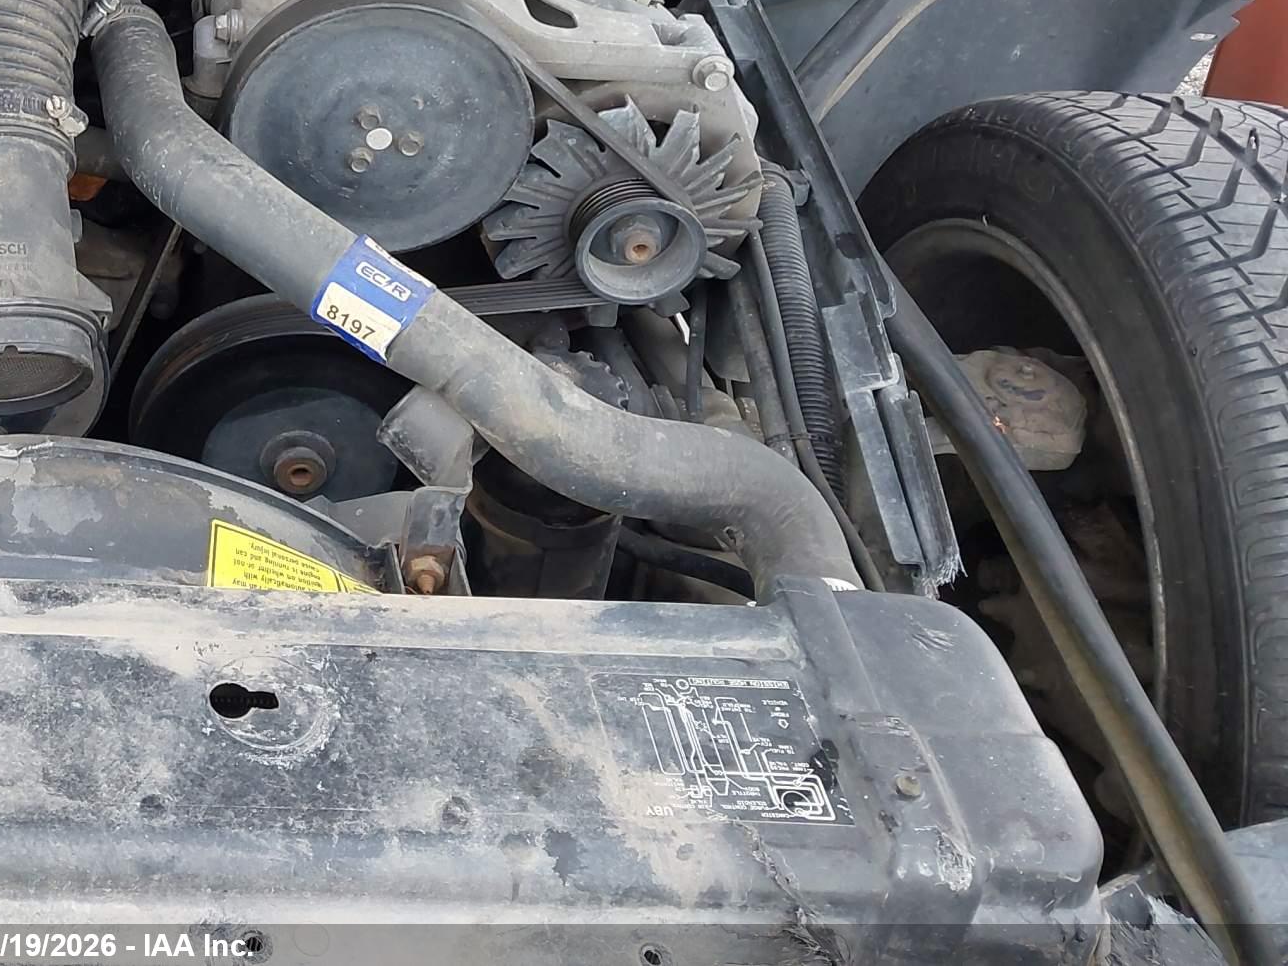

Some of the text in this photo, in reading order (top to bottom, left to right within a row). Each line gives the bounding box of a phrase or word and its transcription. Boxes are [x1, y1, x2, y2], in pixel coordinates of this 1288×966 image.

[326, 304, 377, 341] 8197
[235, 548, 248, 557] can
[233, 558, 245, 568] not
[249, 554, 262, 563] and
[264, 557, 290, 571] running
[271, 551, 299, 566] personal
[257, 565, 285, 578] whether
[301, 562, 320, 573] cause
[243, 570, 258, 581] with
[299, 570, 321, 581] engine
